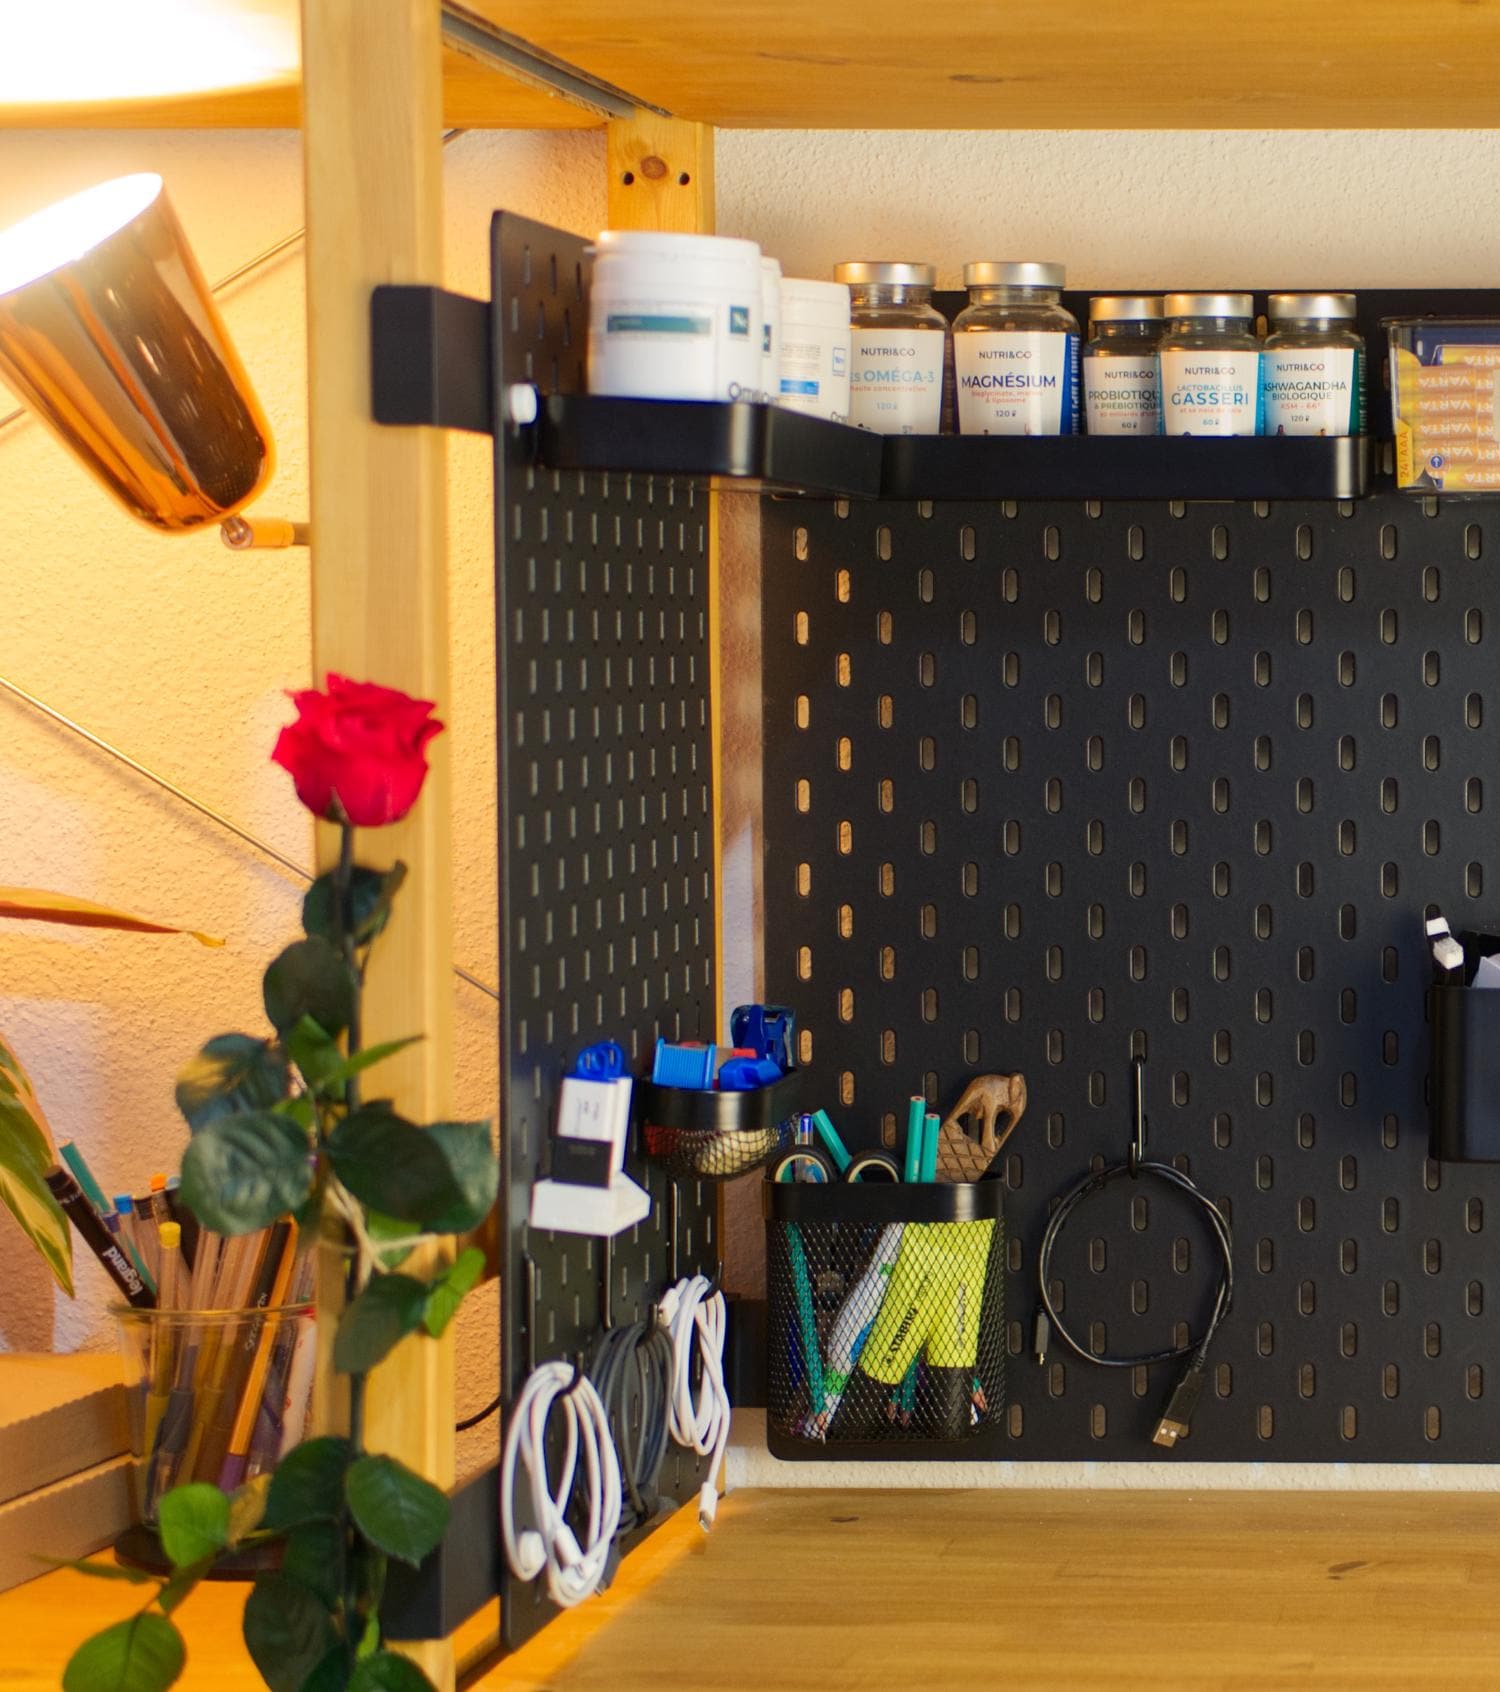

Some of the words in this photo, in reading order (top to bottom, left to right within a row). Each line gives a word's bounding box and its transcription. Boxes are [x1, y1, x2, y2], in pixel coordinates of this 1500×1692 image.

[861, 348, 916, 357] NUTRI&CO
[978, 351, 1032, 359] NUTRI&CO
[1184, 367, 1236, 375] NUTRI&CO
[1276, 363, 1325, 372] NUTRI&CO
[1104, 370, 1154, 379] NUTRI&CO
[961, 372, 1056, 388] MAGNÉSIUM
[1419, 378, 1471, 388] VARTA
[1177, 384, 1243, 392] LACTOBACILLUS
[1171, 392, 1249, 405] GASSERI
[1272, 392, 1334, 401] BIOLOGIQUE
[1419, 400, 1471, 411] VARTA
[1420, 424, 1472, 435] VARTA
[1421, 447, 1473, 458] VARTA
[102, 1246, 144, 1296] legrand
